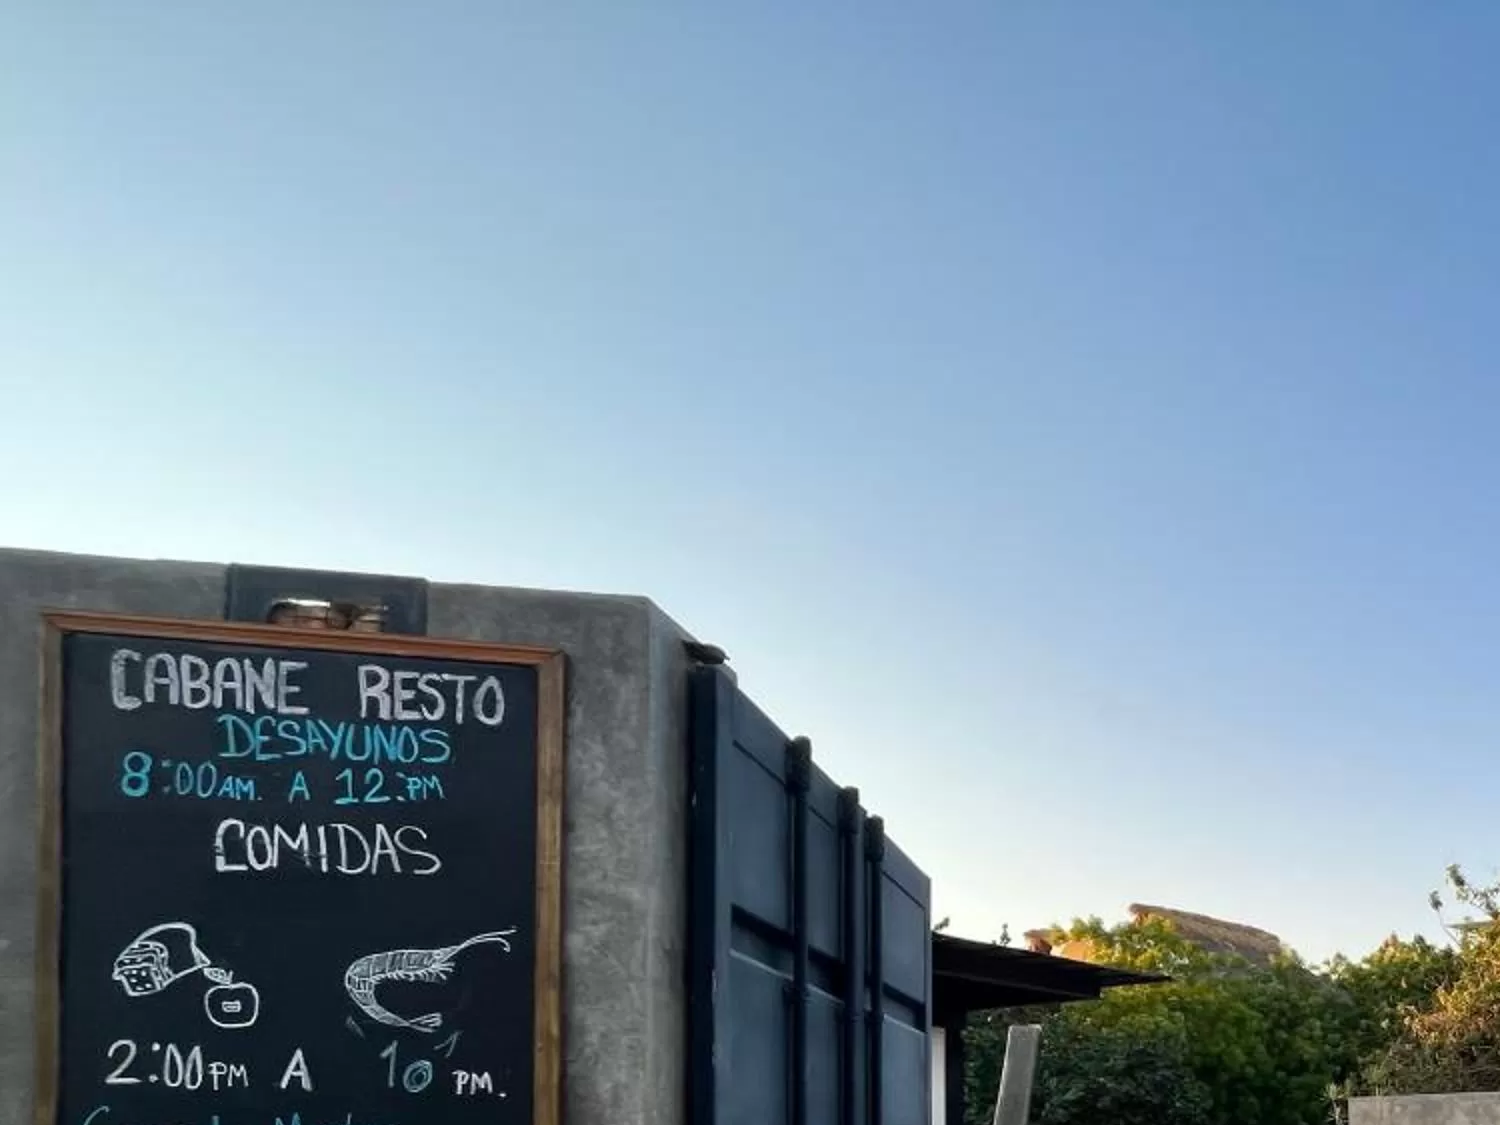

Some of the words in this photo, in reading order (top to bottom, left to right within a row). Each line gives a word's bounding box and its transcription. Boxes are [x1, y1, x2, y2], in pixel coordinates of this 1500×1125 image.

[110, 648, 310, 715] CABANE
[357, 663, 506, 726] RESTO
[217, 714, 451, 764] DESAYUNOS
[288, 771, 311, 803] A
[213, 818, 443, 875] COMIDAS
[280, 1047, 313, 1092] A
[379, 1040, 434, 1093] 10
